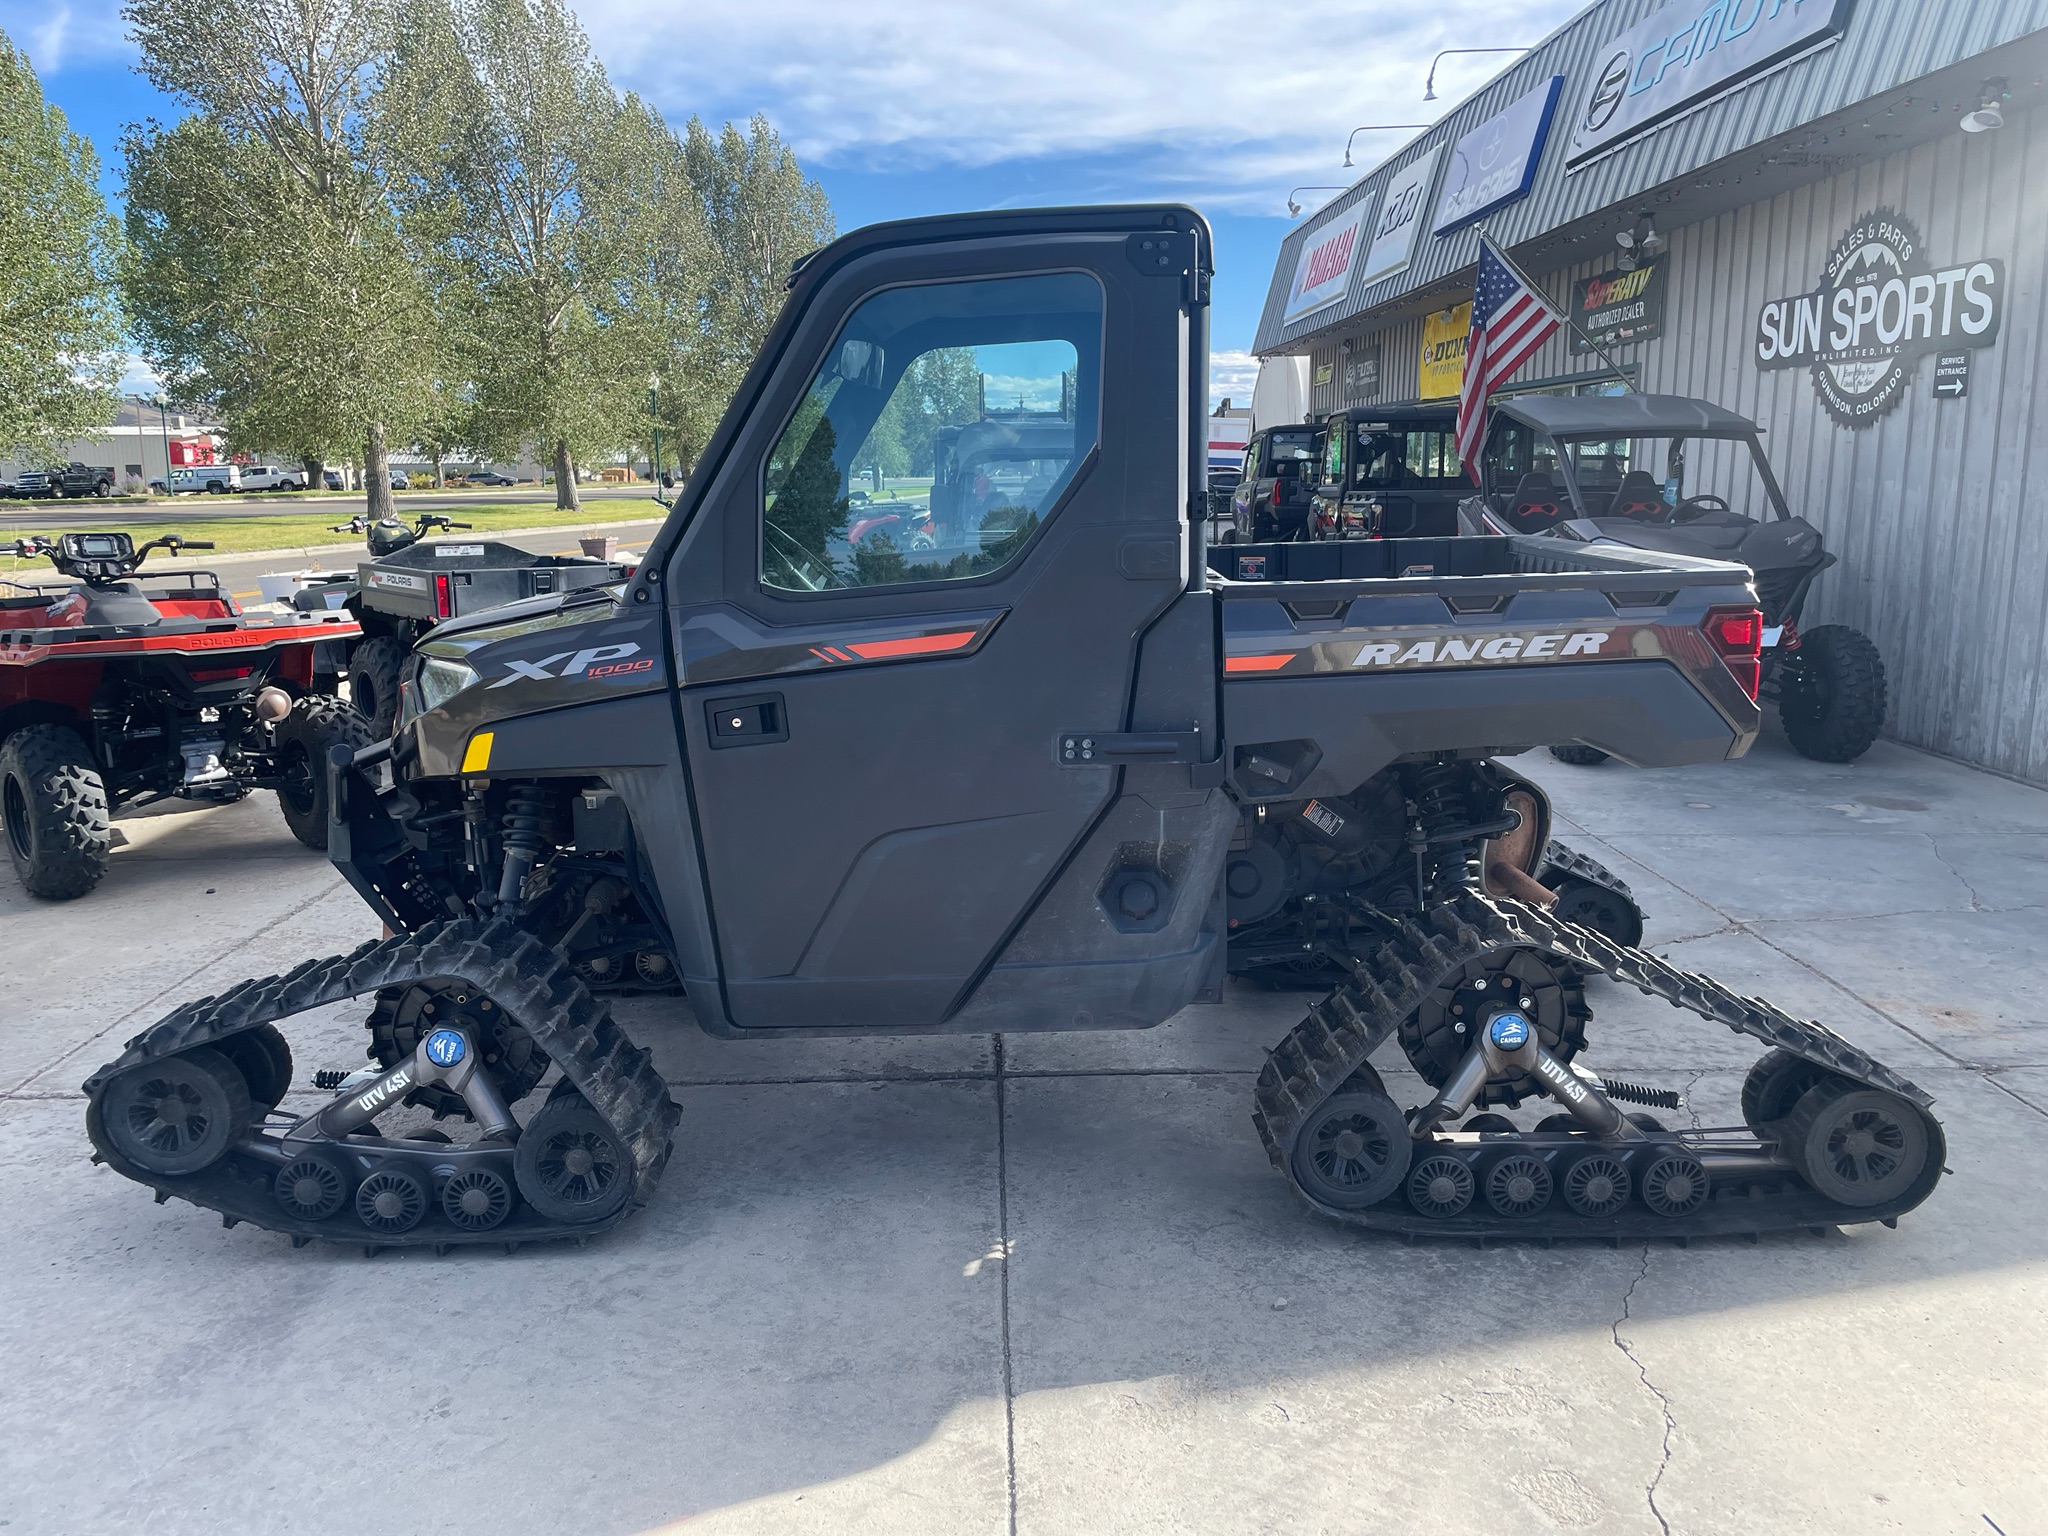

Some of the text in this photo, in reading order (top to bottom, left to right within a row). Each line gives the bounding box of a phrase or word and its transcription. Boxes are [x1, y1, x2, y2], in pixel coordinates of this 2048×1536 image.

[1629, 0, 1804, 97] CFMO
[1440, 154, 1521, 226] POLARIS
[1376, 181, 1423, 241] KTM
[1303, 222, 1358, 294] YAMAHA
[1828, 222, 1912, 277] SALES & PARTS
[1855, 276, 1866, 284] Est.
[1588, 301, 1645, 331] AUTHORIZED DEALER
[1759, 263, 1995, 361] SUN SPORTS
[1815, 345, 1902, 361] UNLIMITED, INC.
[1941, 356, 1965, 365] SERVICE
[1937, 366, 1967, 376] ENTRANCE
[1856, 368, 1902, 415] COLORADO
[386, 575, 412, 587] POLARIS
[191, 635, 259, 649] POLARIS
[1352, 632, 1609, 666] RANGER
[484, 642, 641, 690] XP
[588, 659, 654, 677] 1000
[445, 1042, 457, 1063] CAMSO
[1540, 1058, 1568, 1084] UTV
[359, 1086, 386, 1111] UTV
